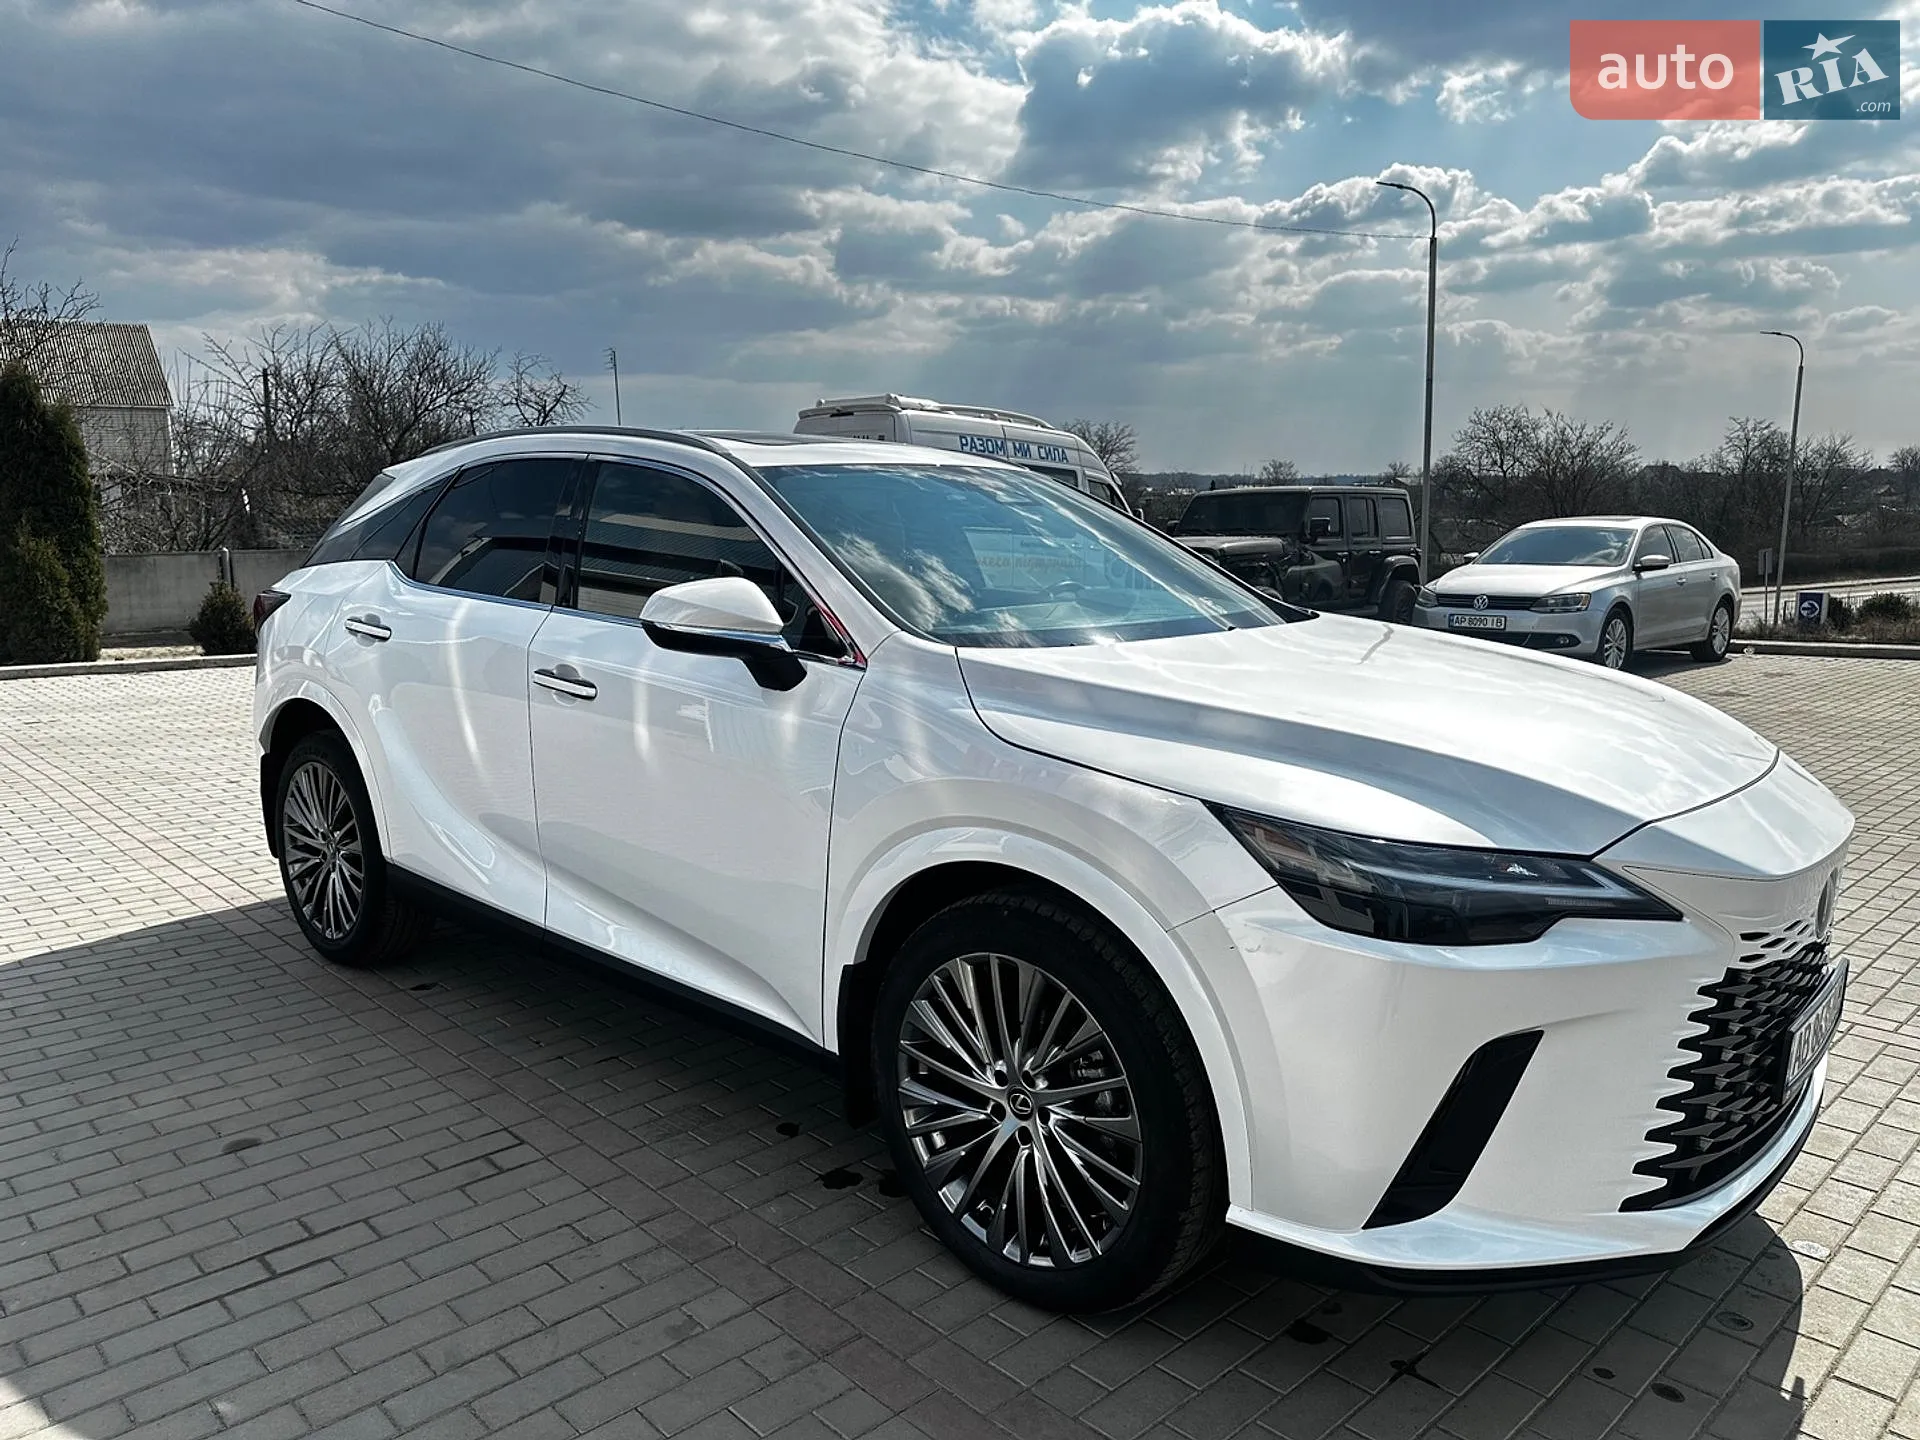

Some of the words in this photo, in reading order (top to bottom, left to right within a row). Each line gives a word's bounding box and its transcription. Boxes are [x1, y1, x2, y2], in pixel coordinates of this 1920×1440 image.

[959, 435, 1006, 455] РАЗОМ
[1012, 441, 1032, 459] МИ
[1037, 445, 1069, 463] СИЛА
